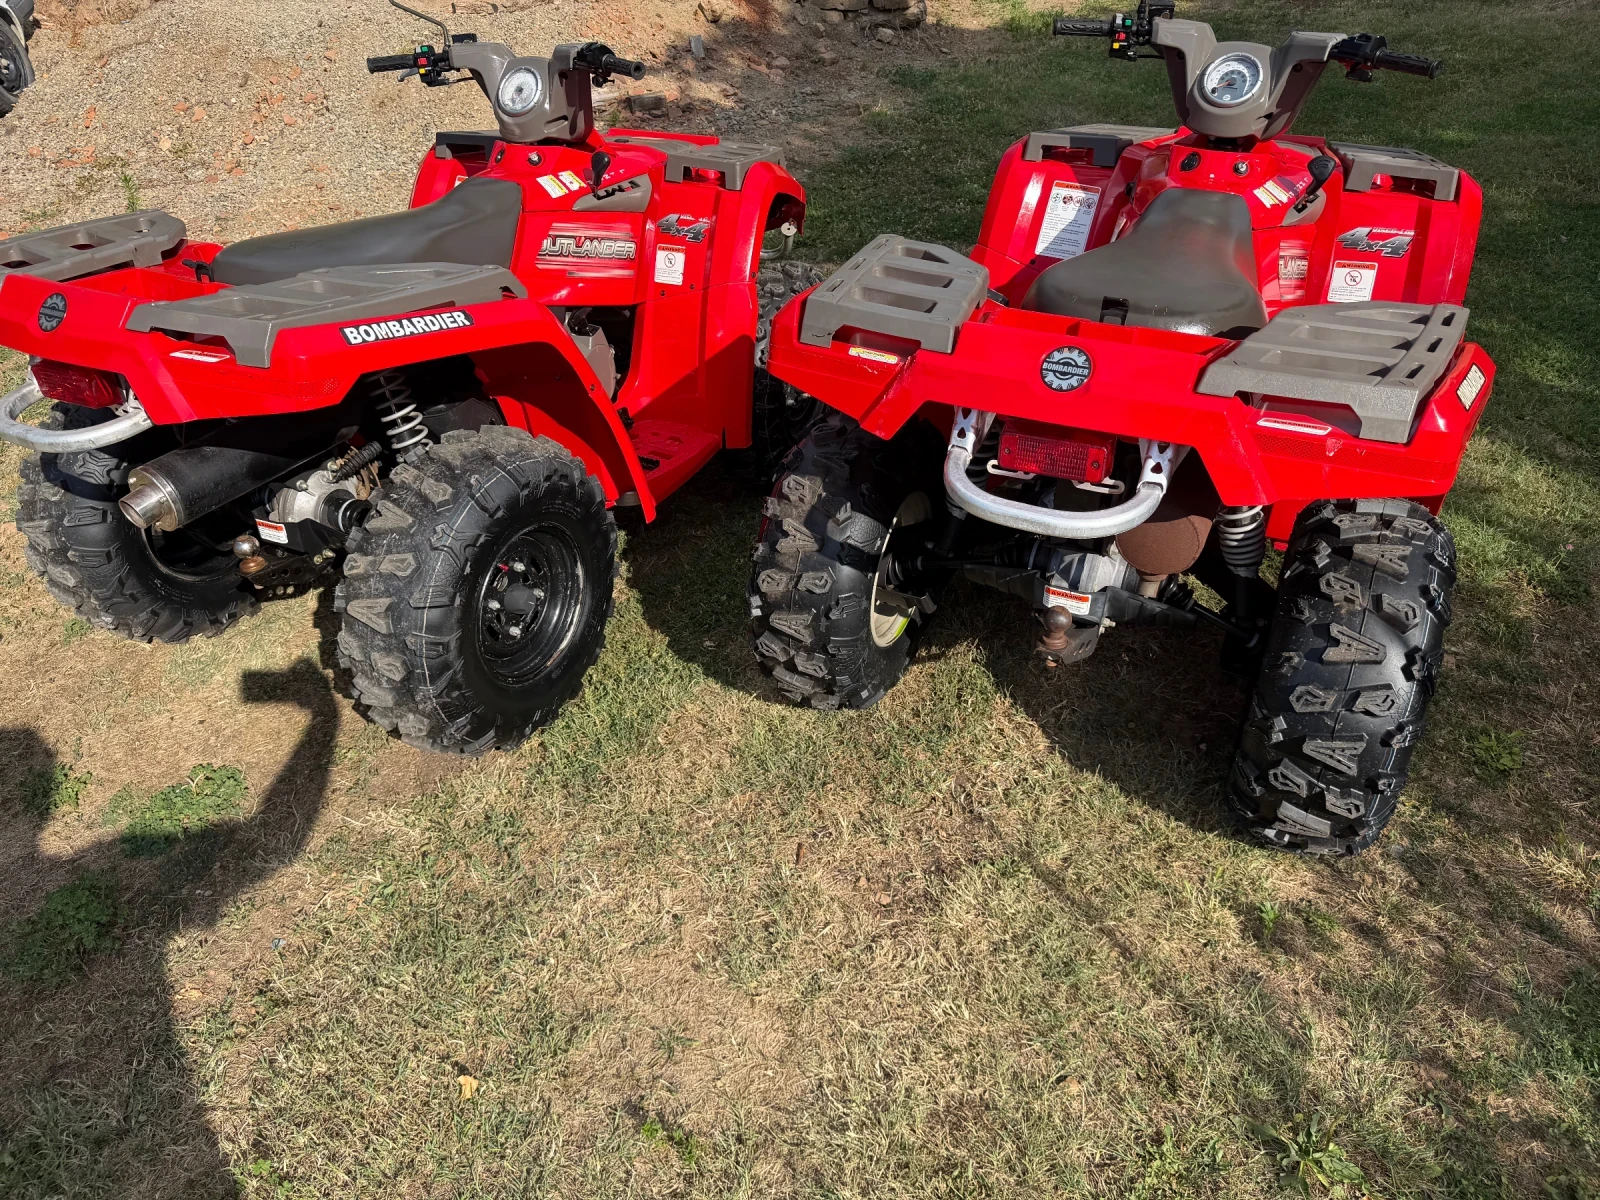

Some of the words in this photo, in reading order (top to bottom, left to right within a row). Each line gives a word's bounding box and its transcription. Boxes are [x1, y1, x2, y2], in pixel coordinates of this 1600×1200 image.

[657, 213, 711, 243] 4x4
[1337, 227, 1413, 257] 4x4
[344, 311, 470, 344] BOMBARDIER
[1042, 362, 1089, 376] BOMBARDIER
